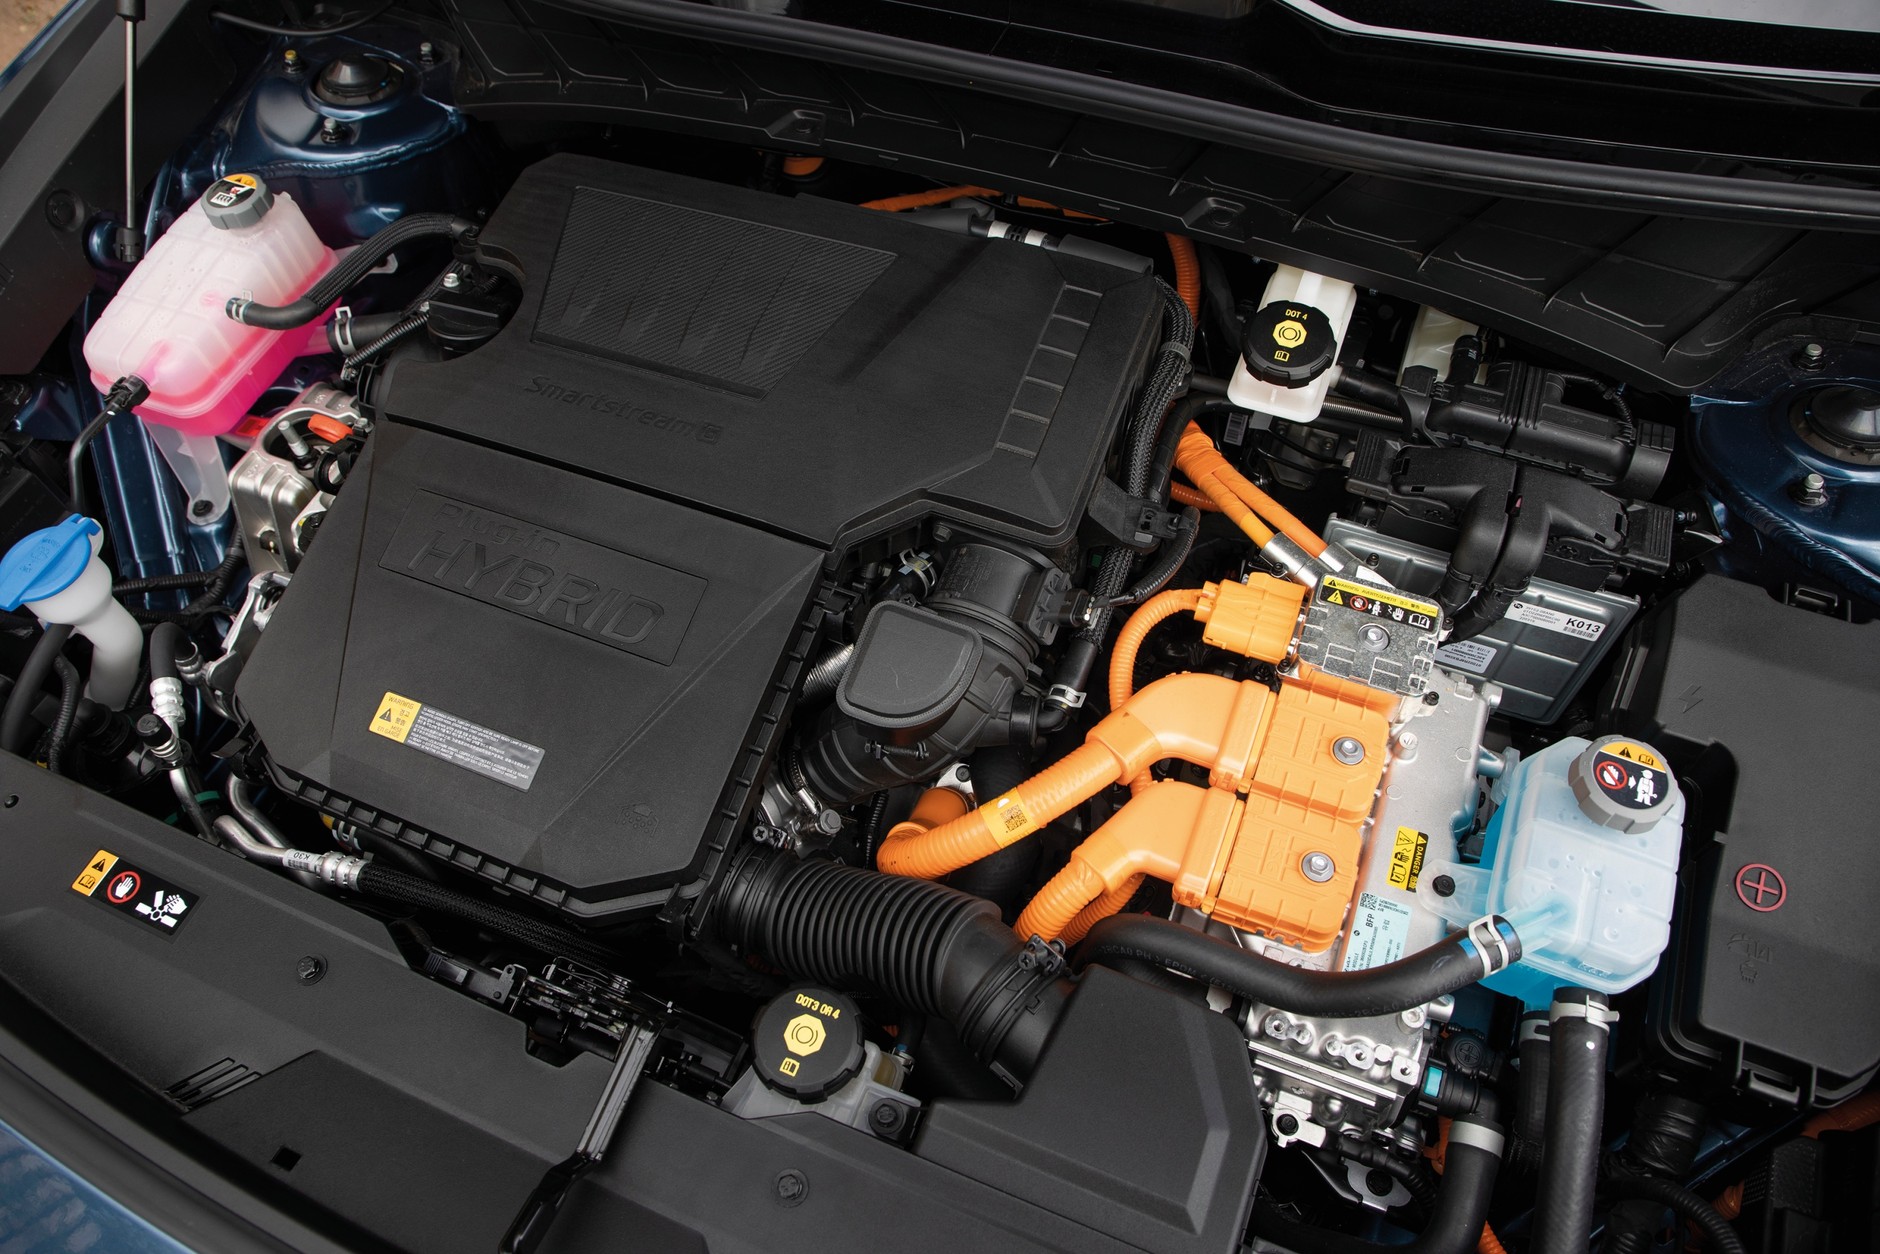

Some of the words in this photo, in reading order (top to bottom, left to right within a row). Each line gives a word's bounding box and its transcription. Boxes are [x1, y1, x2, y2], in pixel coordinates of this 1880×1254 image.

[1285, 308, 1301, 318] DOT
[524, 375, 696, 436] Smartstream
[433, 503, 560, 555] Plug-in
[407, 530, 664, 644] HYBRID
[1566, 618, 1601, 633] K013
[388, 696, 414, 709] WARNING
[294, 852, 311, 860] K30
[1412, 845, 1424, 874] DANGER
[1364, 912, 1375, 928] BFP
[795, 993, 819, 1011] DOT3
[819, 1004, 833, 1016] OR
[832, 1009, 840, 1019] 4
